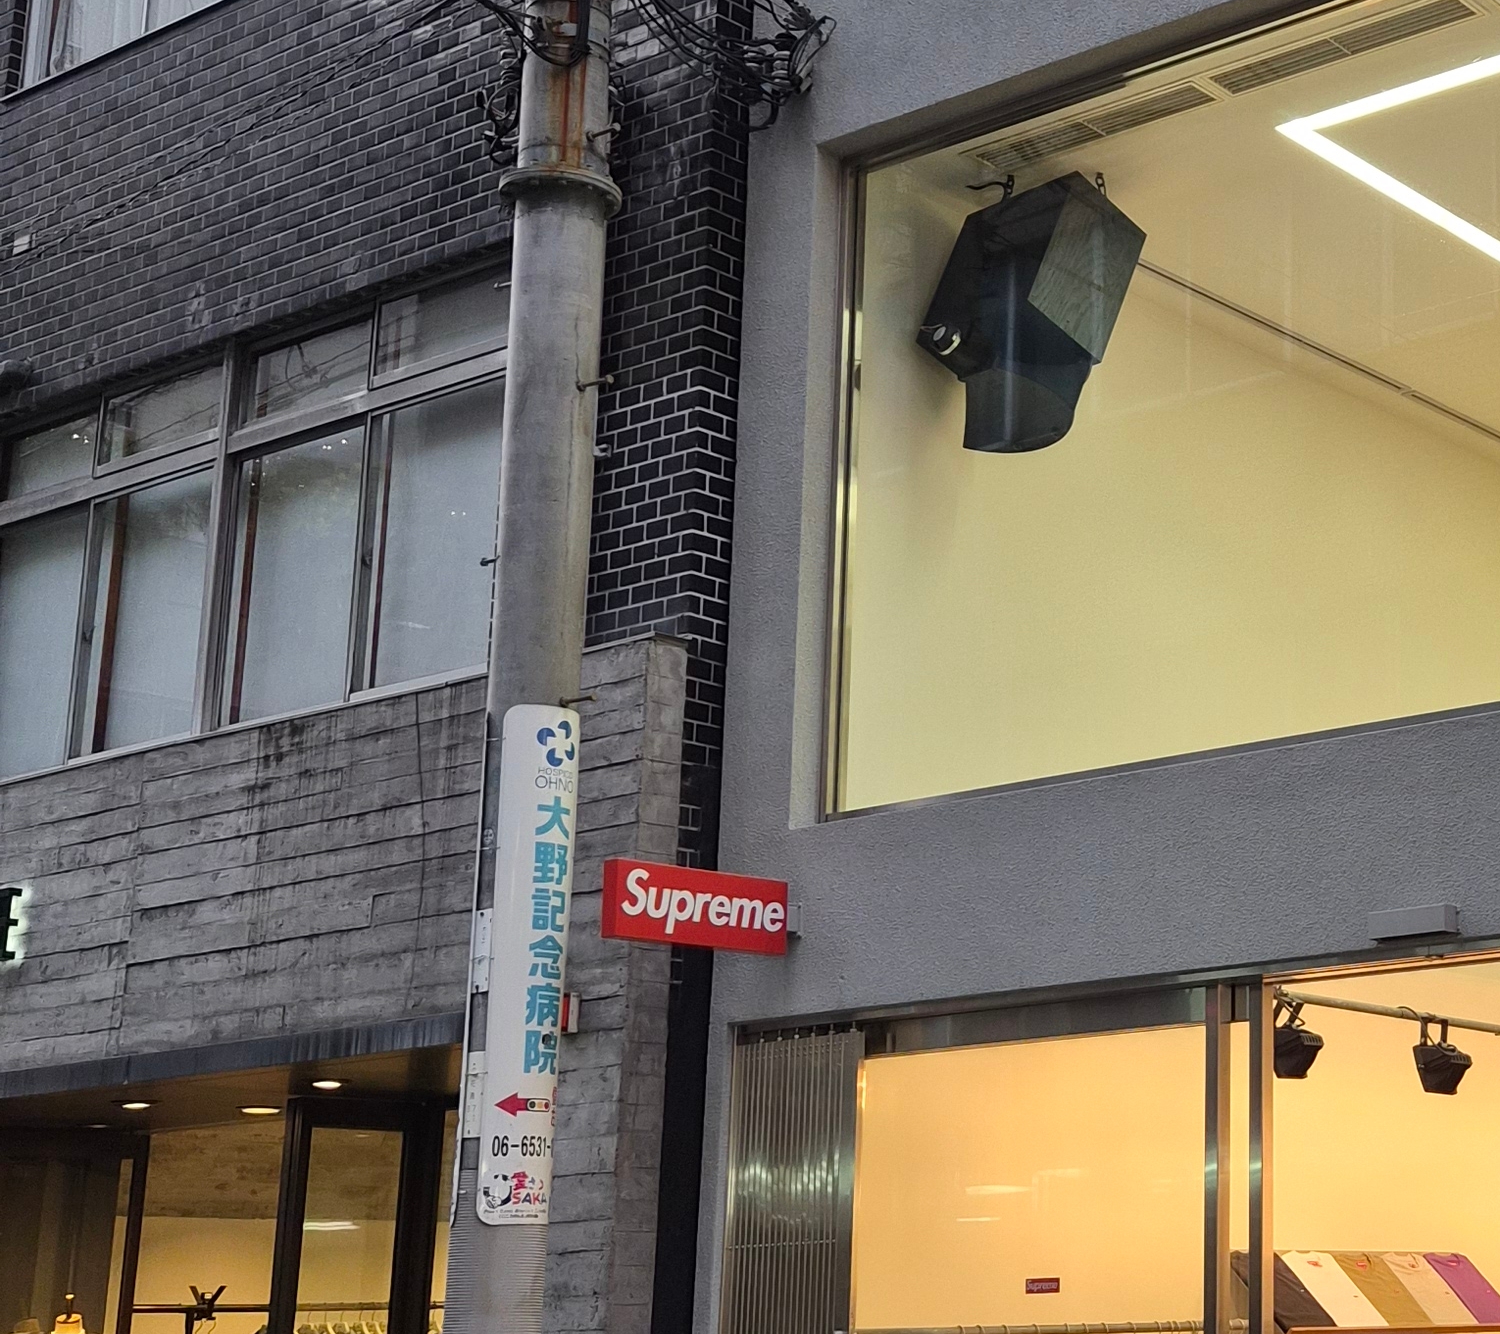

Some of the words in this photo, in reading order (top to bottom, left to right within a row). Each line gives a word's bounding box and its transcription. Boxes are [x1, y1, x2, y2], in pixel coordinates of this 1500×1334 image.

[534, 774, 574, 794] OHNO
[621, 868, 785, 933] Supreme
[523, 795, 572, 1076] 大野記念病院
[491, 1135, 554, 1159] 06-6531-
